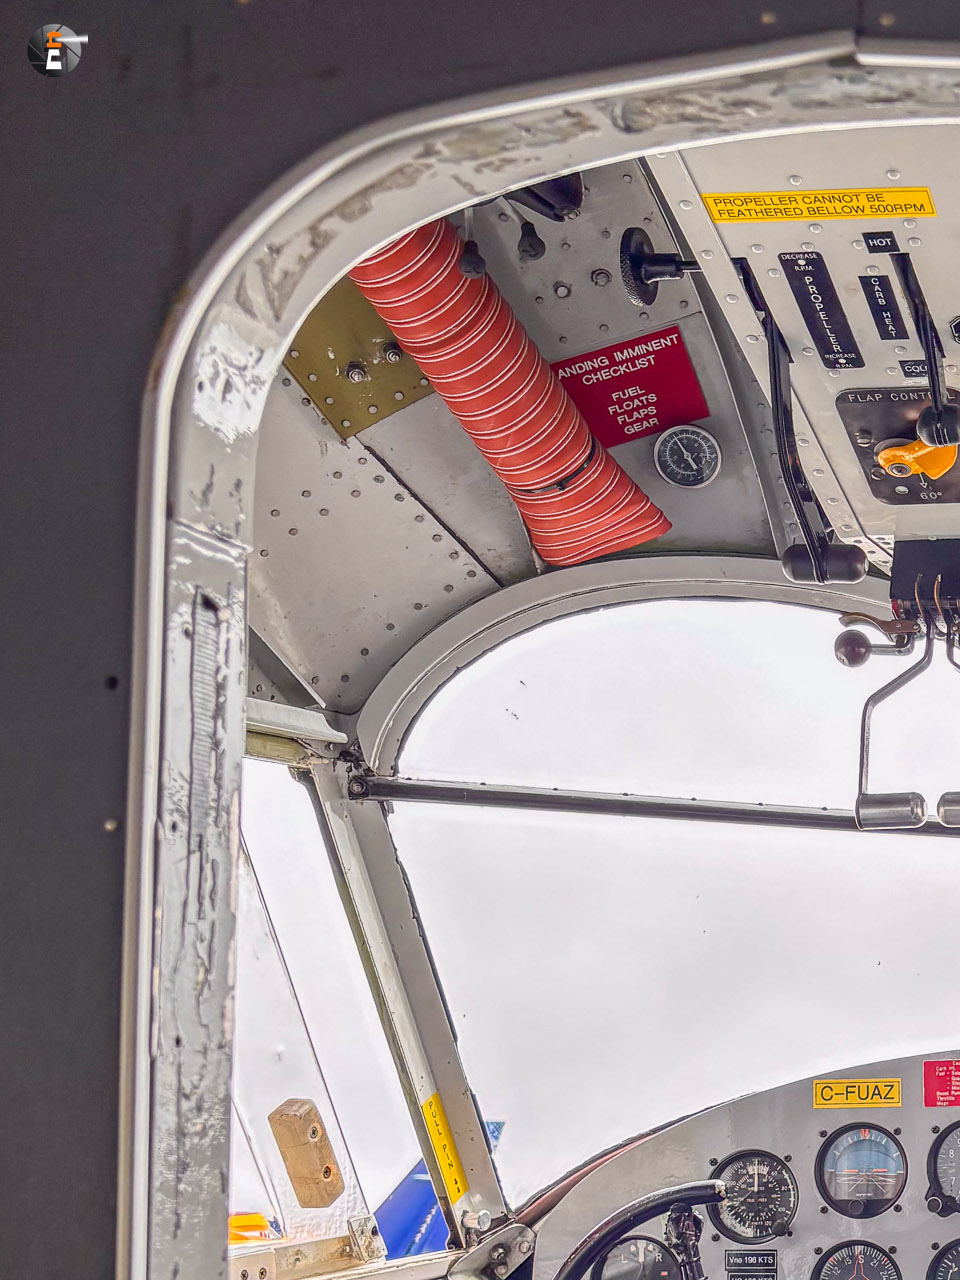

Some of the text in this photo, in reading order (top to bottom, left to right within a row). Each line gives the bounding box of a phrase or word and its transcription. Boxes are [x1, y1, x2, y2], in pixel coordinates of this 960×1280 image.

[714, 193, 886, 207] PROPELLER CANNOT BE
[718, 204, 925, 218] FEATHERED BELLOW 500RPM
[805, 276, 842, 352] PROPELLER
[871, 278, 897, 337] CARB HEAT
[558, 334, 678, 379] ANDING IMMINENT
[582, 355, 656, 385] CHECKLIST
[611, 386, 645, 401] FUEL
[848, 394, 883, 402] FLAP
[608, 393, 657, 415] FLOATS
[617, 406, 656, 425] FLAPS
[624, 418, 660, 434] GEAR
[820, 1085, 895, 1101] C-FUAZ
[429, 1101, 454, 1170] PULL PIN
[949, 1150, 954, 1158] 8
[950, 1177, 956, 1185] 7
[622, 1253, 662, 1263] L R
[858, 1255, 864, 1263] S
